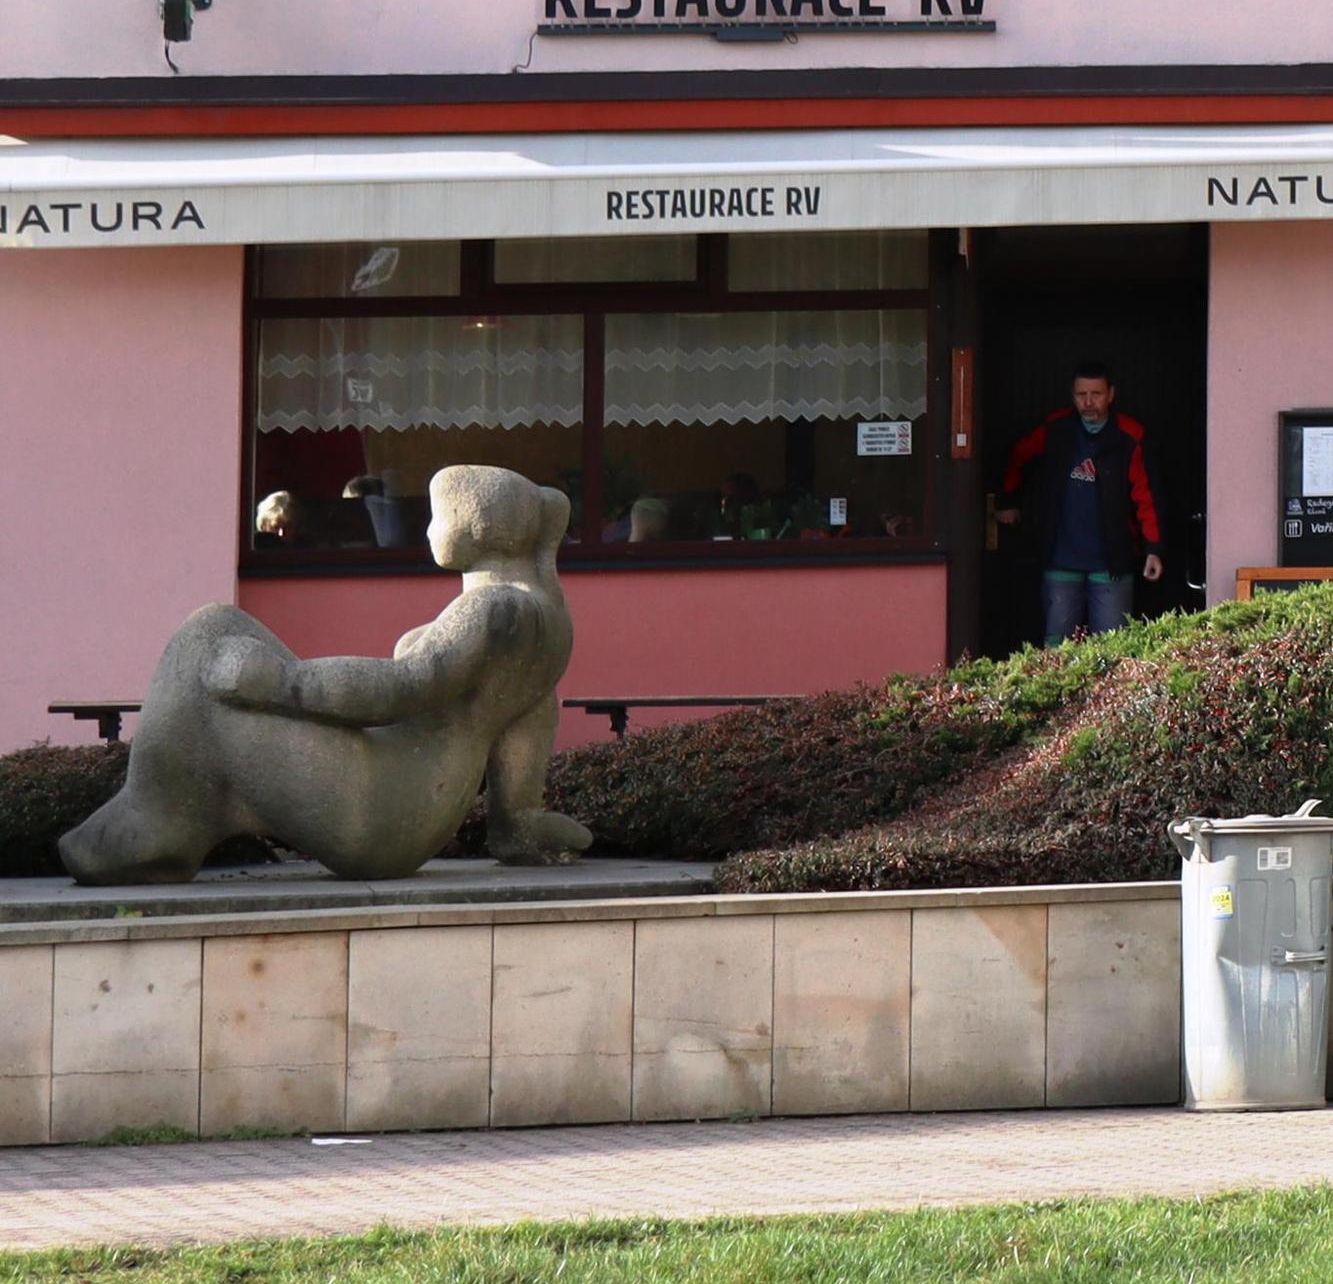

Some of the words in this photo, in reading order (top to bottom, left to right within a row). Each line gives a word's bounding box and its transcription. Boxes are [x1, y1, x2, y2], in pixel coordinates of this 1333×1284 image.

[0, 200, 206, 234] ATURA
[606, 187, 775, 220] RESTAURACE
[785, 186, 821, 216] RV
